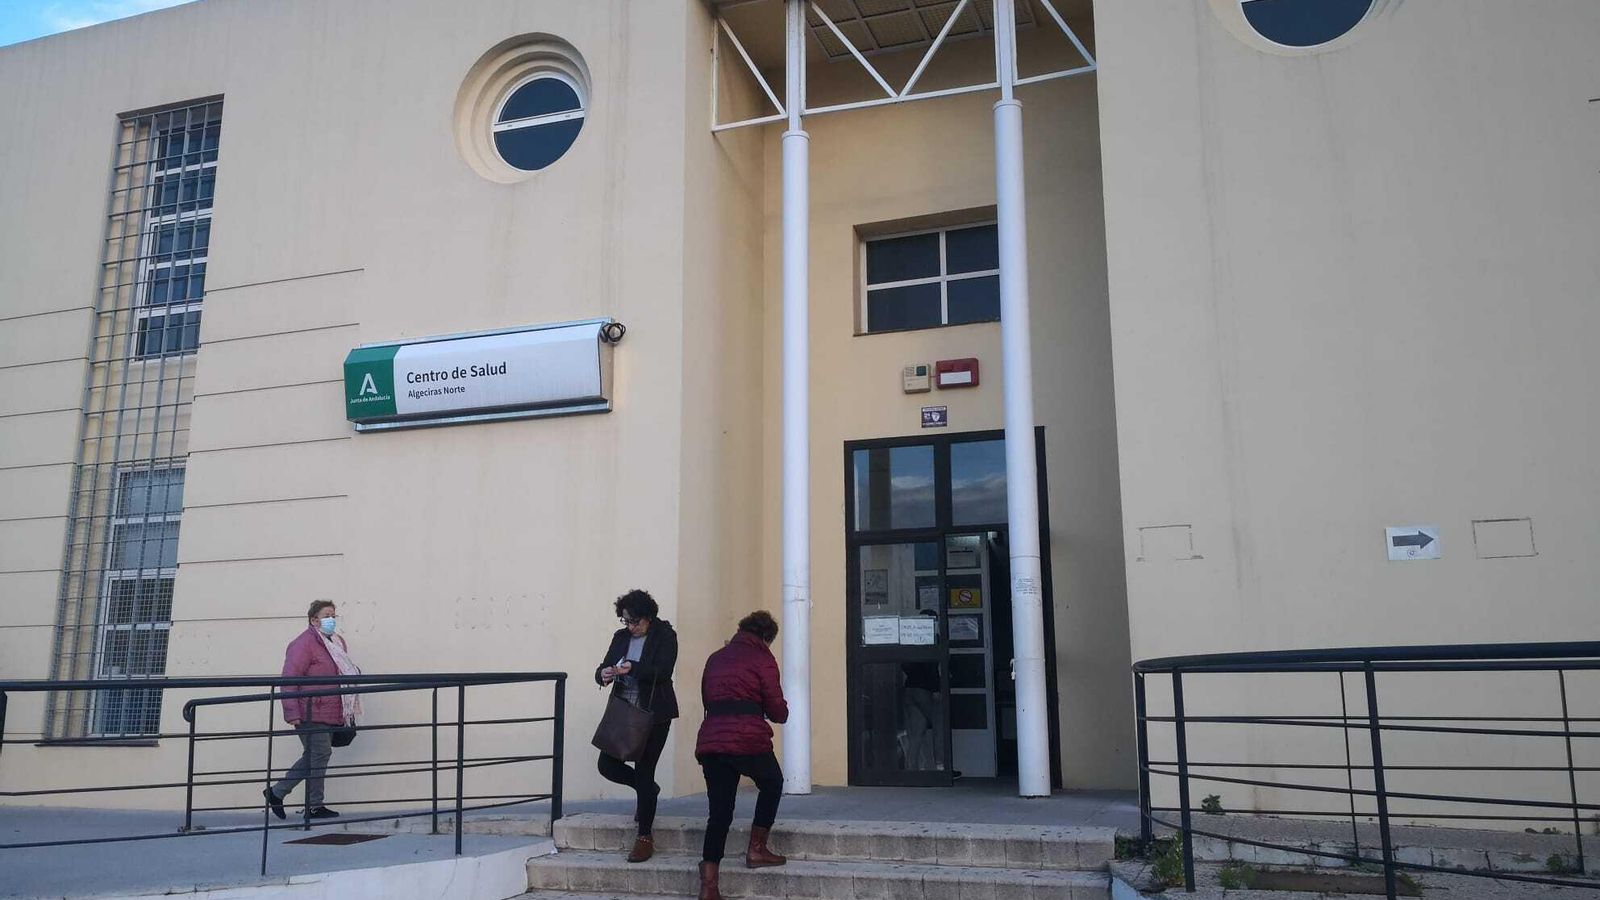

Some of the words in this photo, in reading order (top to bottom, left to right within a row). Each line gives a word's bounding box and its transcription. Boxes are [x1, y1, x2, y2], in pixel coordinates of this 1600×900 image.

[406, 369, 449, 384] Centro
[451, 366, 467, 380] de
[470, 361, 507, 377] Salud
[408, 387, 442, 400] Algeciras
[443, 386, 466, 395] Norte
